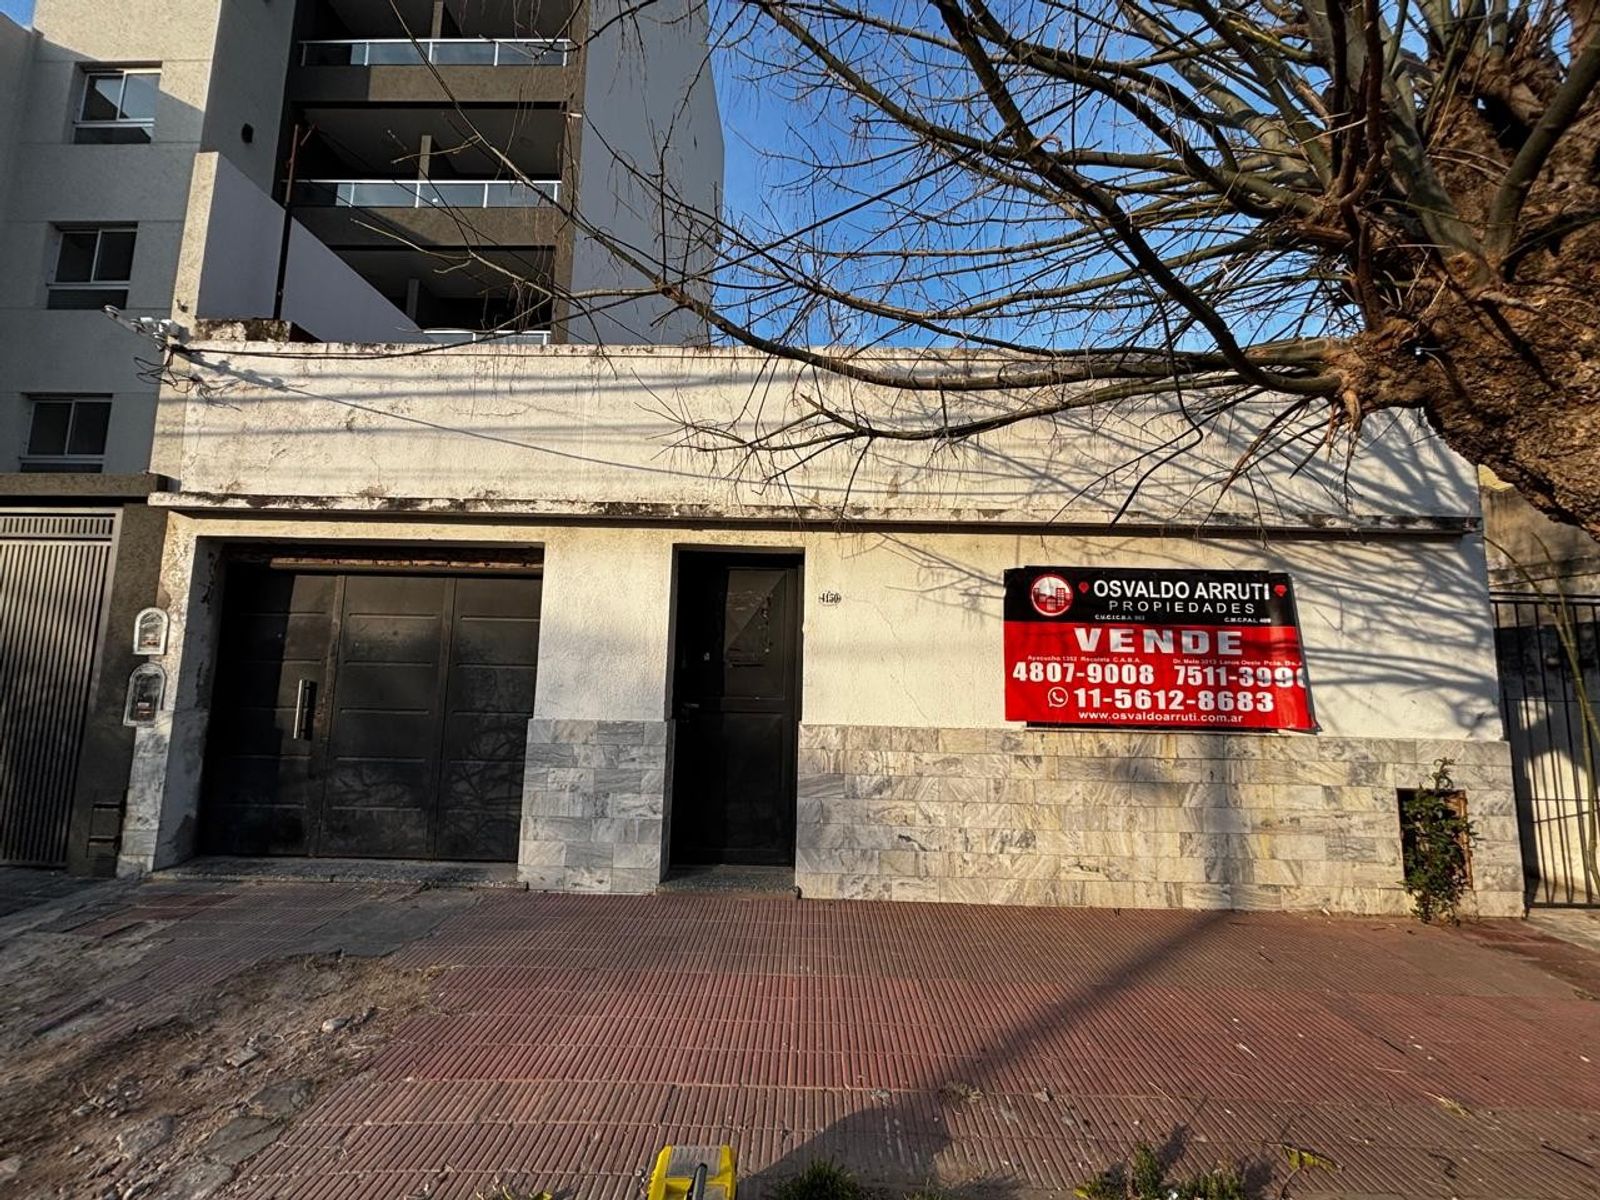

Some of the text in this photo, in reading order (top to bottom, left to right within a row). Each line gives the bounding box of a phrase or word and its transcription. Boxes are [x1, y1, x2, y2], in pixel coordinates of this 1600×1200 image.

[1093, 580, 1270, 601] OSVALDO ARRUTI
[1109, 600, 1255, 614] PROPIEDADES
[1074, 627, 1243, 655] VENDE
[1012, 661, 1155, 684] 4807-9008
[1073, 688, 1275, 712] 11-5612-8683
[1078, 711, 1244, 723] www.osvaldoarruti.com.ar
